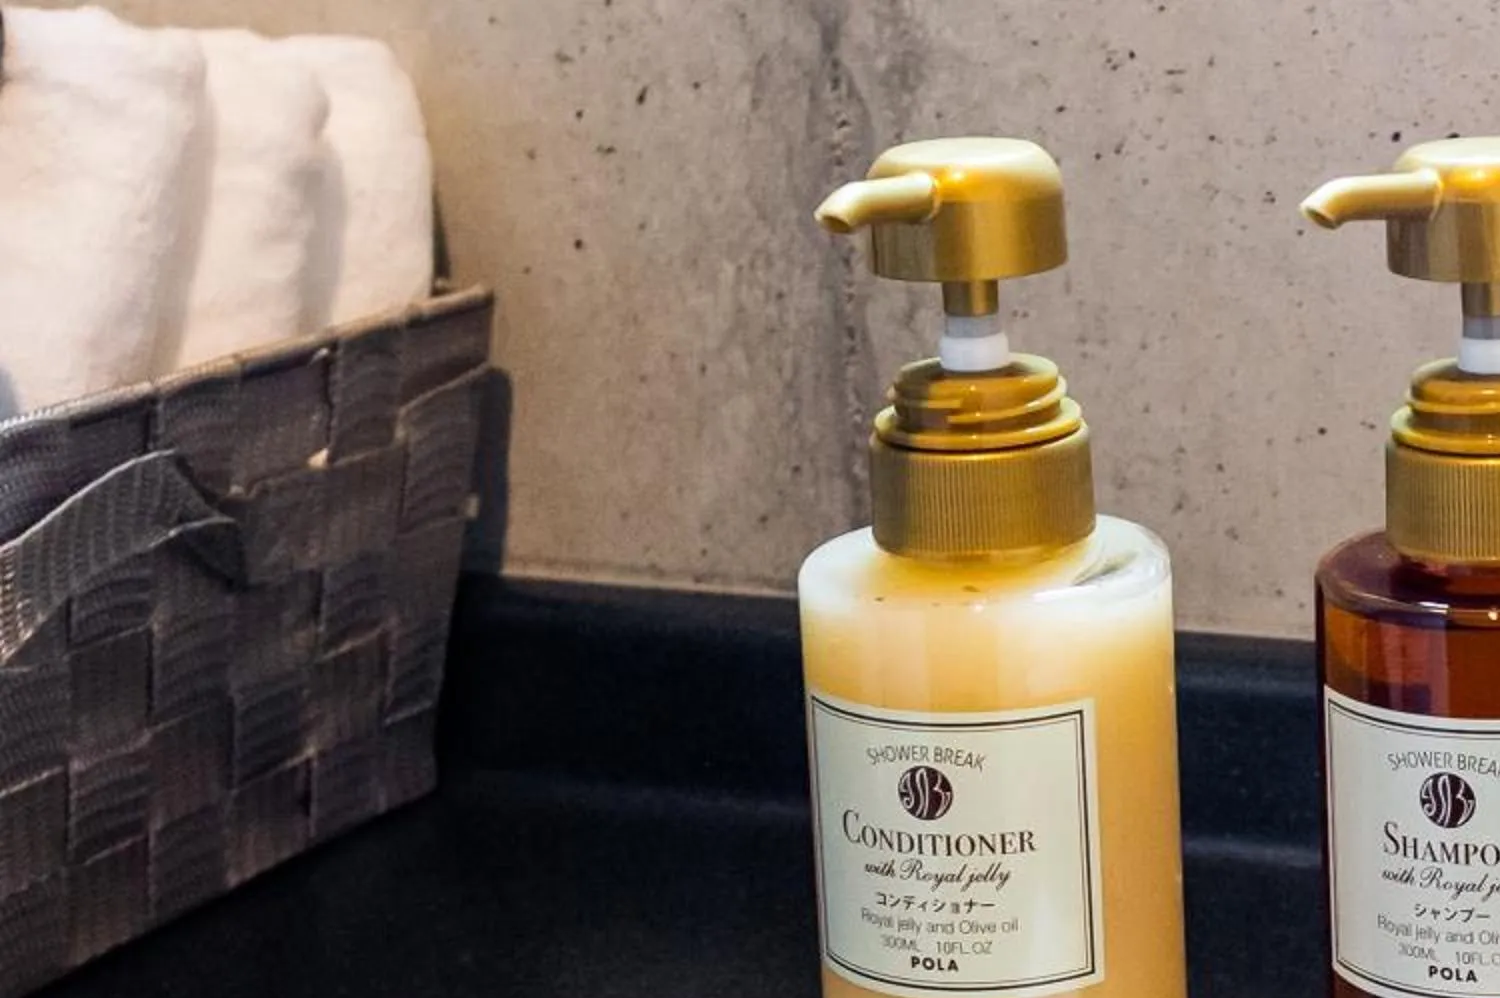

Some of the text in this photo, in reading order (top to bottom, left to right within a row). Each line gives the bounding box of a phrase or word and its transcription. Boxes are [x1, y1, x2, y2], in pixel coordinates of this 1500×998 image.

[866, 745, 987, 772] SHOWER BREAK
[1387, 751, 1453, 772] SHOWER
[842, 809, 1037, 857] CONDITIONER
[864, 858, 1012, 892] with Royal jelly
[1381, 866, 1417, 886] with
[1419, 866, 1486, 900] Royal
[876, 892, 995, 914] コンディショナー
[1414, 903, 1491, 923] シャンプー
[861, 907, 1019, 935] Royal jelly and Olive oil
[1377, 913, 1412, 938] Royal
[1414, 922, 1441, 944] jelly
[1445, 926, 1475, 944] and
[910, 955, 959, 972] POLA
[1428, 965, 1479, 983] POLA
